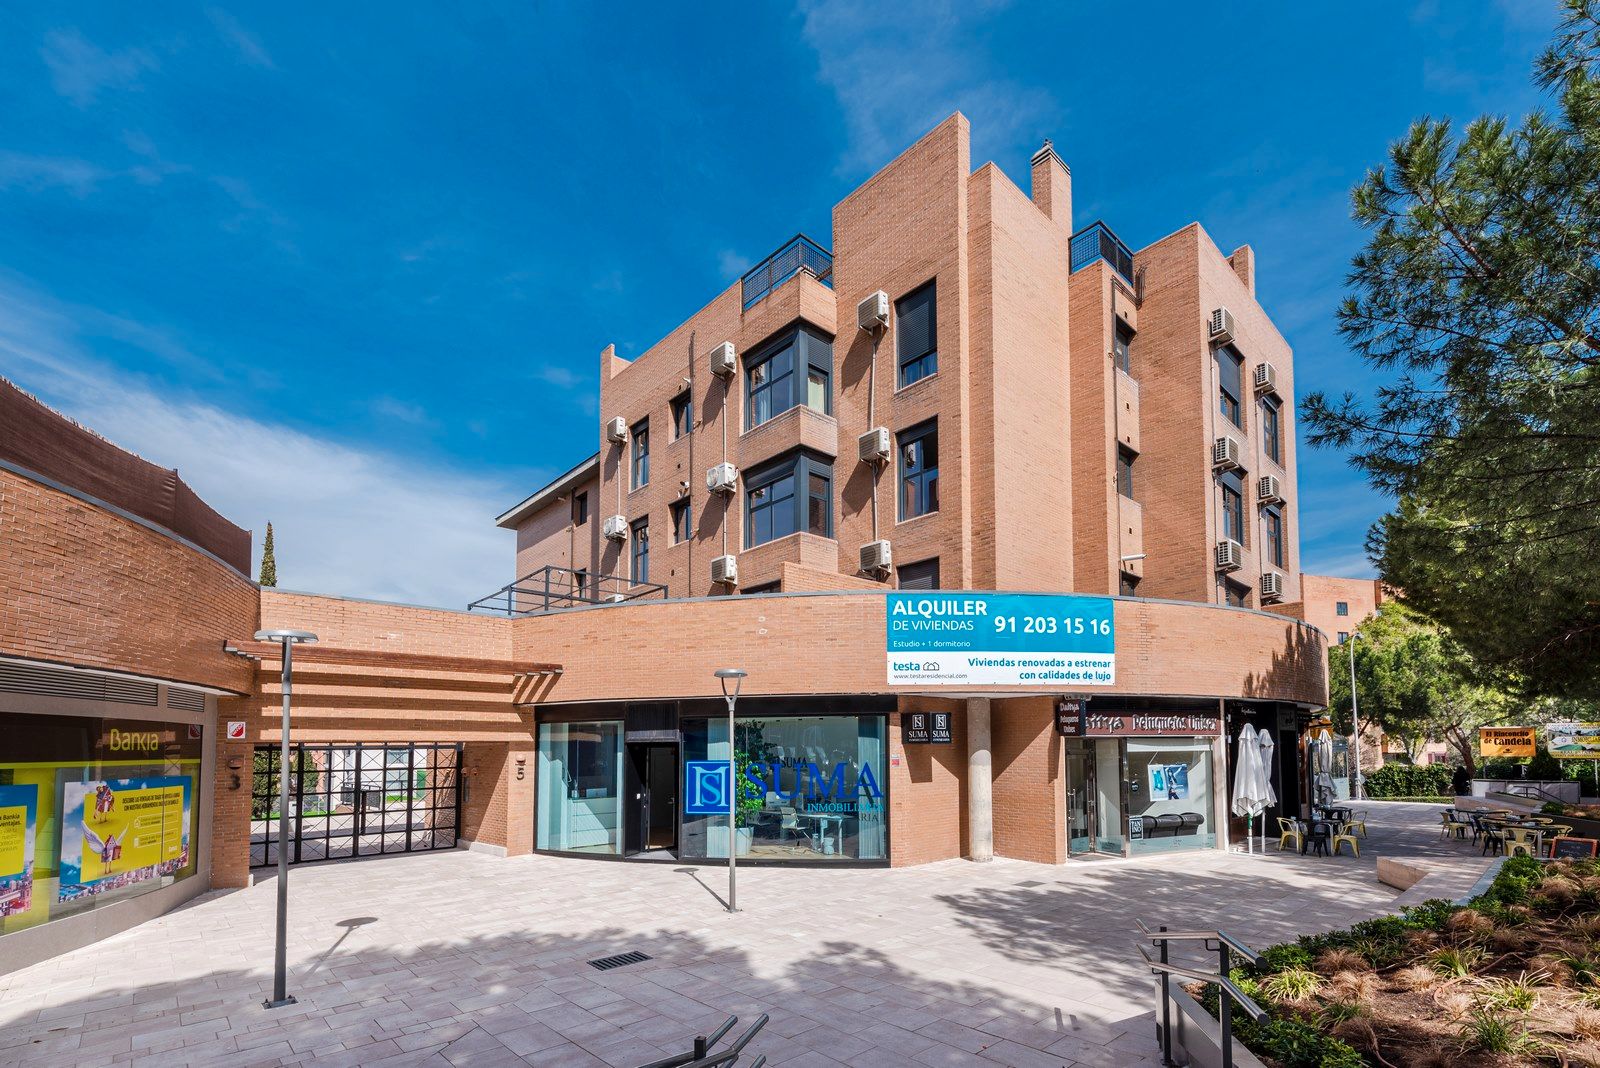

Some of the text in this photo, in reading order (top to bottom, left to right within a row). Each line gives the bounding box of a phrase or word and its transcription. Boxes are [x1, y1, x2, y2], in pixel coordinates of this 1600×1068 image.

[892, 600, 988, 619] ALQUILER
[893, 620, 975, 631] DE VIVIENDAS
[994, 615, 1110, 636] 91 203 15 16
[893, 640, 920, 648] Estudio
[933, 640, 971, 648] dormitorio
[893, 661, 920, 671] testa
[968, 657, 1111, 669] Viviendas renovadas a estrenar
[1019, 670, 1111, 682] con calidades de lujo
[110, 728, 159, 751] Bankia
[908, 730, 928, 738] SUMA
[932, 730, 950, 738] SUMA
[1494, 737, 1532, 746] Candela
[744, 762, 884, 801] SUMA
[807, 803, 884, 813] INMOBILIARIA
